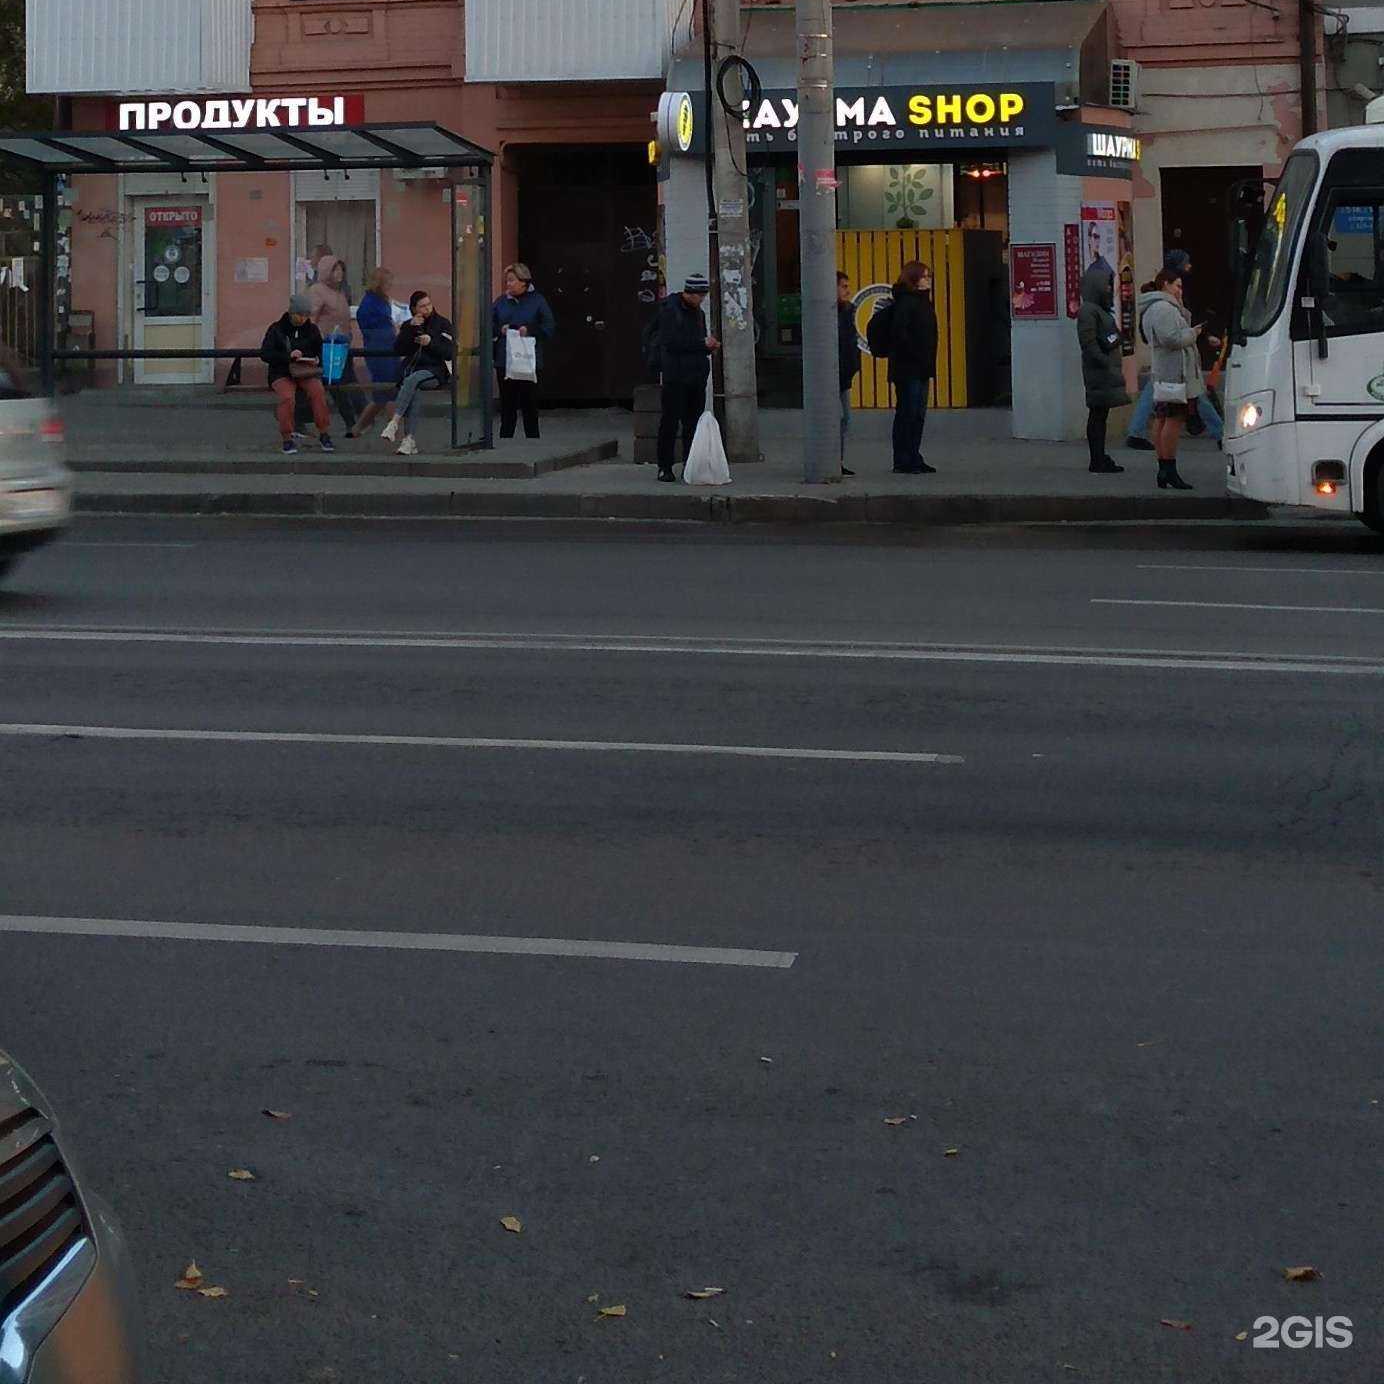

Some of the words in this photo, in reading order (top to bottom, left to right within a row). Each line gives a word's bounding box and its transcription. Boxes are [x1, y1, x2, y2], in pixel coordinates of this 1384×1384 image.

[119, 96, 345, 131] ПРОДУКТЫ
[742, 96, 897, 129] АУМА
[908, 93, 1024, 125] SHOP
[787, 128, 905, 144] бтрого
[919, 126, 1024, 139] питания
[149, 211, 199, 222] ОТКРЫТО
